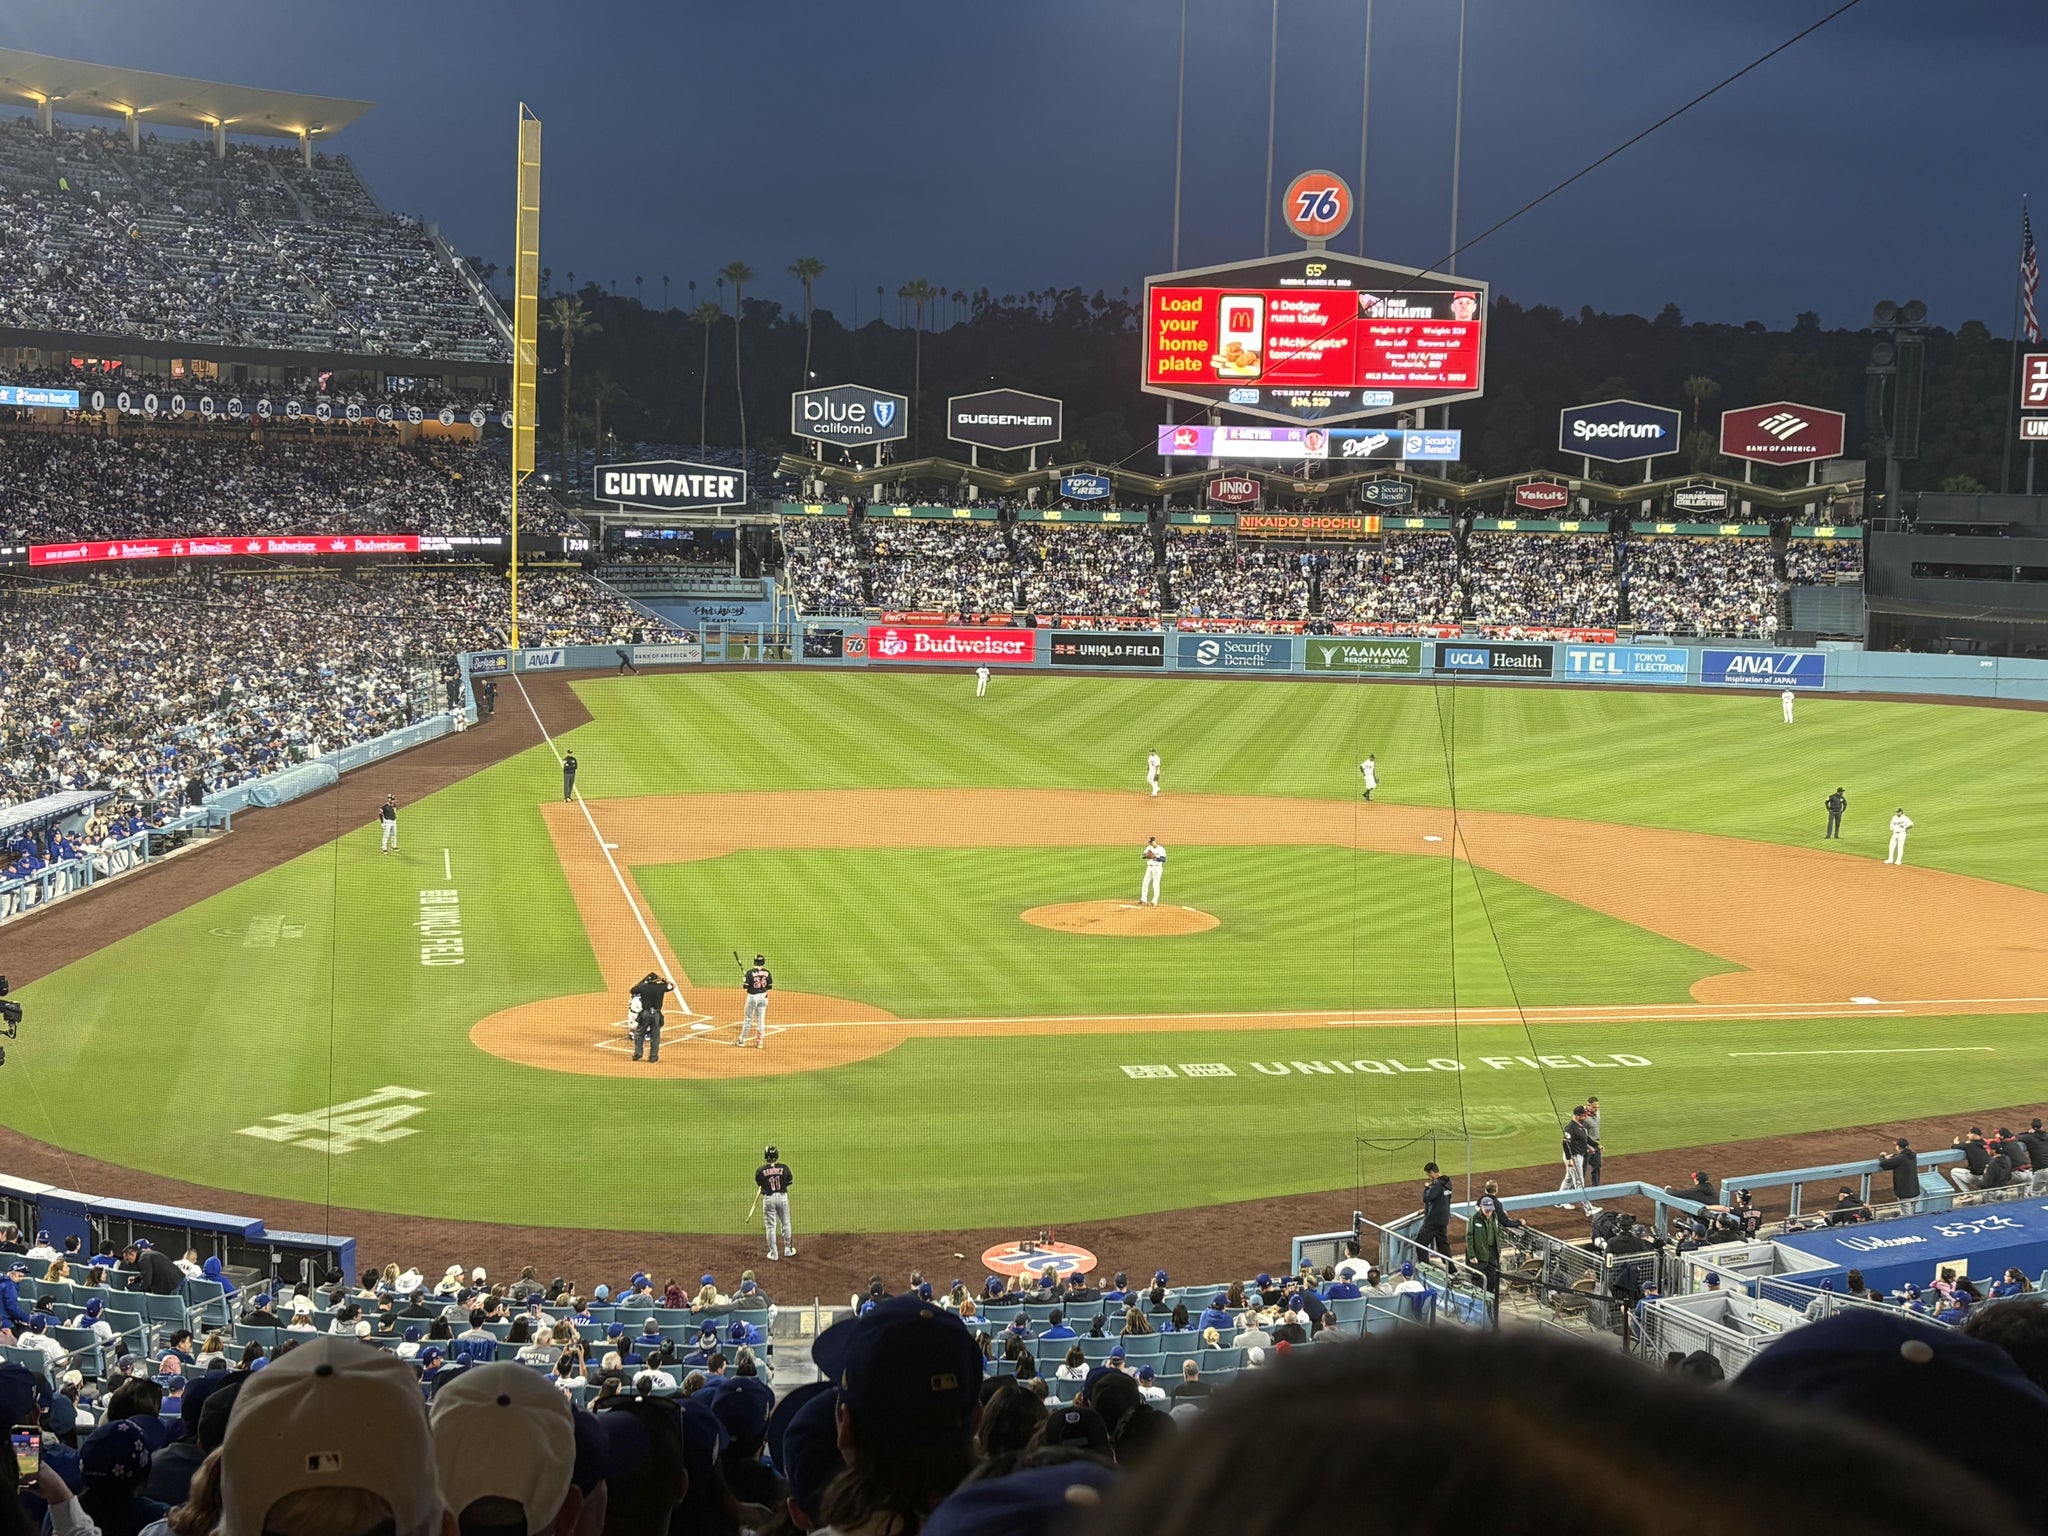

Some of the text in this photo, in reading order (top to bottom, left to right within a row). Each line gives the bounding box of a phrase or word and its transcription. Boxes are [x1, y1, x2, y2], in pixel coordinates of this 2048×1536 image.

[1295, 187, 1340, 223] 76
[1161, 297, 1202, 312] Load
[1271, 301, 1320, 313] 6 Dodger
[1387, 307, 1432, 318] DELAUTER
[1271, 313, 1328, 325] runs today
[1160, 318, 1198, 334] your
[1160, 336, 1208, 351] home
[1270, 337, 1277, 347] 6
[1270, 349, 1322, 360] tomorrow
[1159, 356, 1202, 374] plate
[95, 396, 101, 407] 1
[121, 396, 128, 407] 2
[147, 397, 154, 409] 4
[174, 399, 183, 410] 14
[203, 402, 211, 412] 19
[231, 402, 240, 413] 20
[259, 403, 271, 414] 24
[288, 405, 300, 415] 32
[318, 407, 330, 417] 34
[348, 407, 360, 418] 39
[378, 409, 391, 419] 42
[804, 395, 866, 422] blue
[409, 410, 421, 421] 53
[957, 413, 1052, 426] GUGGENHEIM
[813, 422, 873, 435] california
[1573, 420, 1660, 441] Spectrum
[1342, 433, 1389, 457] Dodgers
[1424, 437, 1457, 447] Security
[1424, 445, 1452, 455] Benefit
[605, 472, 735, 498] CUTWATER
[1067, 479, 1096, 487] TOYO
[1218, 482, 1252, 496] JINRO
[1071, 486, 1105, 494] TIRES
[1381, 485, 1408, 496] Security
[1519, 490, 1565, 501] Yakult
[1240, 516, 1362, 530] NIKAIDO SHOCHU
[190, 541, 232, 554] Budweiser
[268, 540, 316, 551] Budweiser
[354, 540, 406, 551] Budweiser
[847, 638, 865, 653] 76
[914, 633, 1025, 654] Budweiser
[1224, 641, 1272, 655] Security
[1080, 645, 1122, 658] UNIQLO
[1126, 645, 1160, 656] FIELD
[1635, 653, 1667, 662] TOKYO
[528, 655, 550, 666] ANA
[1225, 653, 1266, 666] Benefit
[1450, 653, 1542, 668] UCLA Health
[1569, 651, 1623, 674] TEL
[1726, 656, 1773, 674] ANA
[1635, 663, 1684, 673] ELECTRON
[1725, 676, 1797, 686] Inspiration of JAPAN
[420, 938, 466, 966] FIELD
[1249, 1054, 1653, 1075] UNIQLO FIELD
[769, 1176, 781, 1191] 11
[1932, 1215, 2025, 1238] ようこそ
[1836, 1235, 1927, 1252] Welcome
